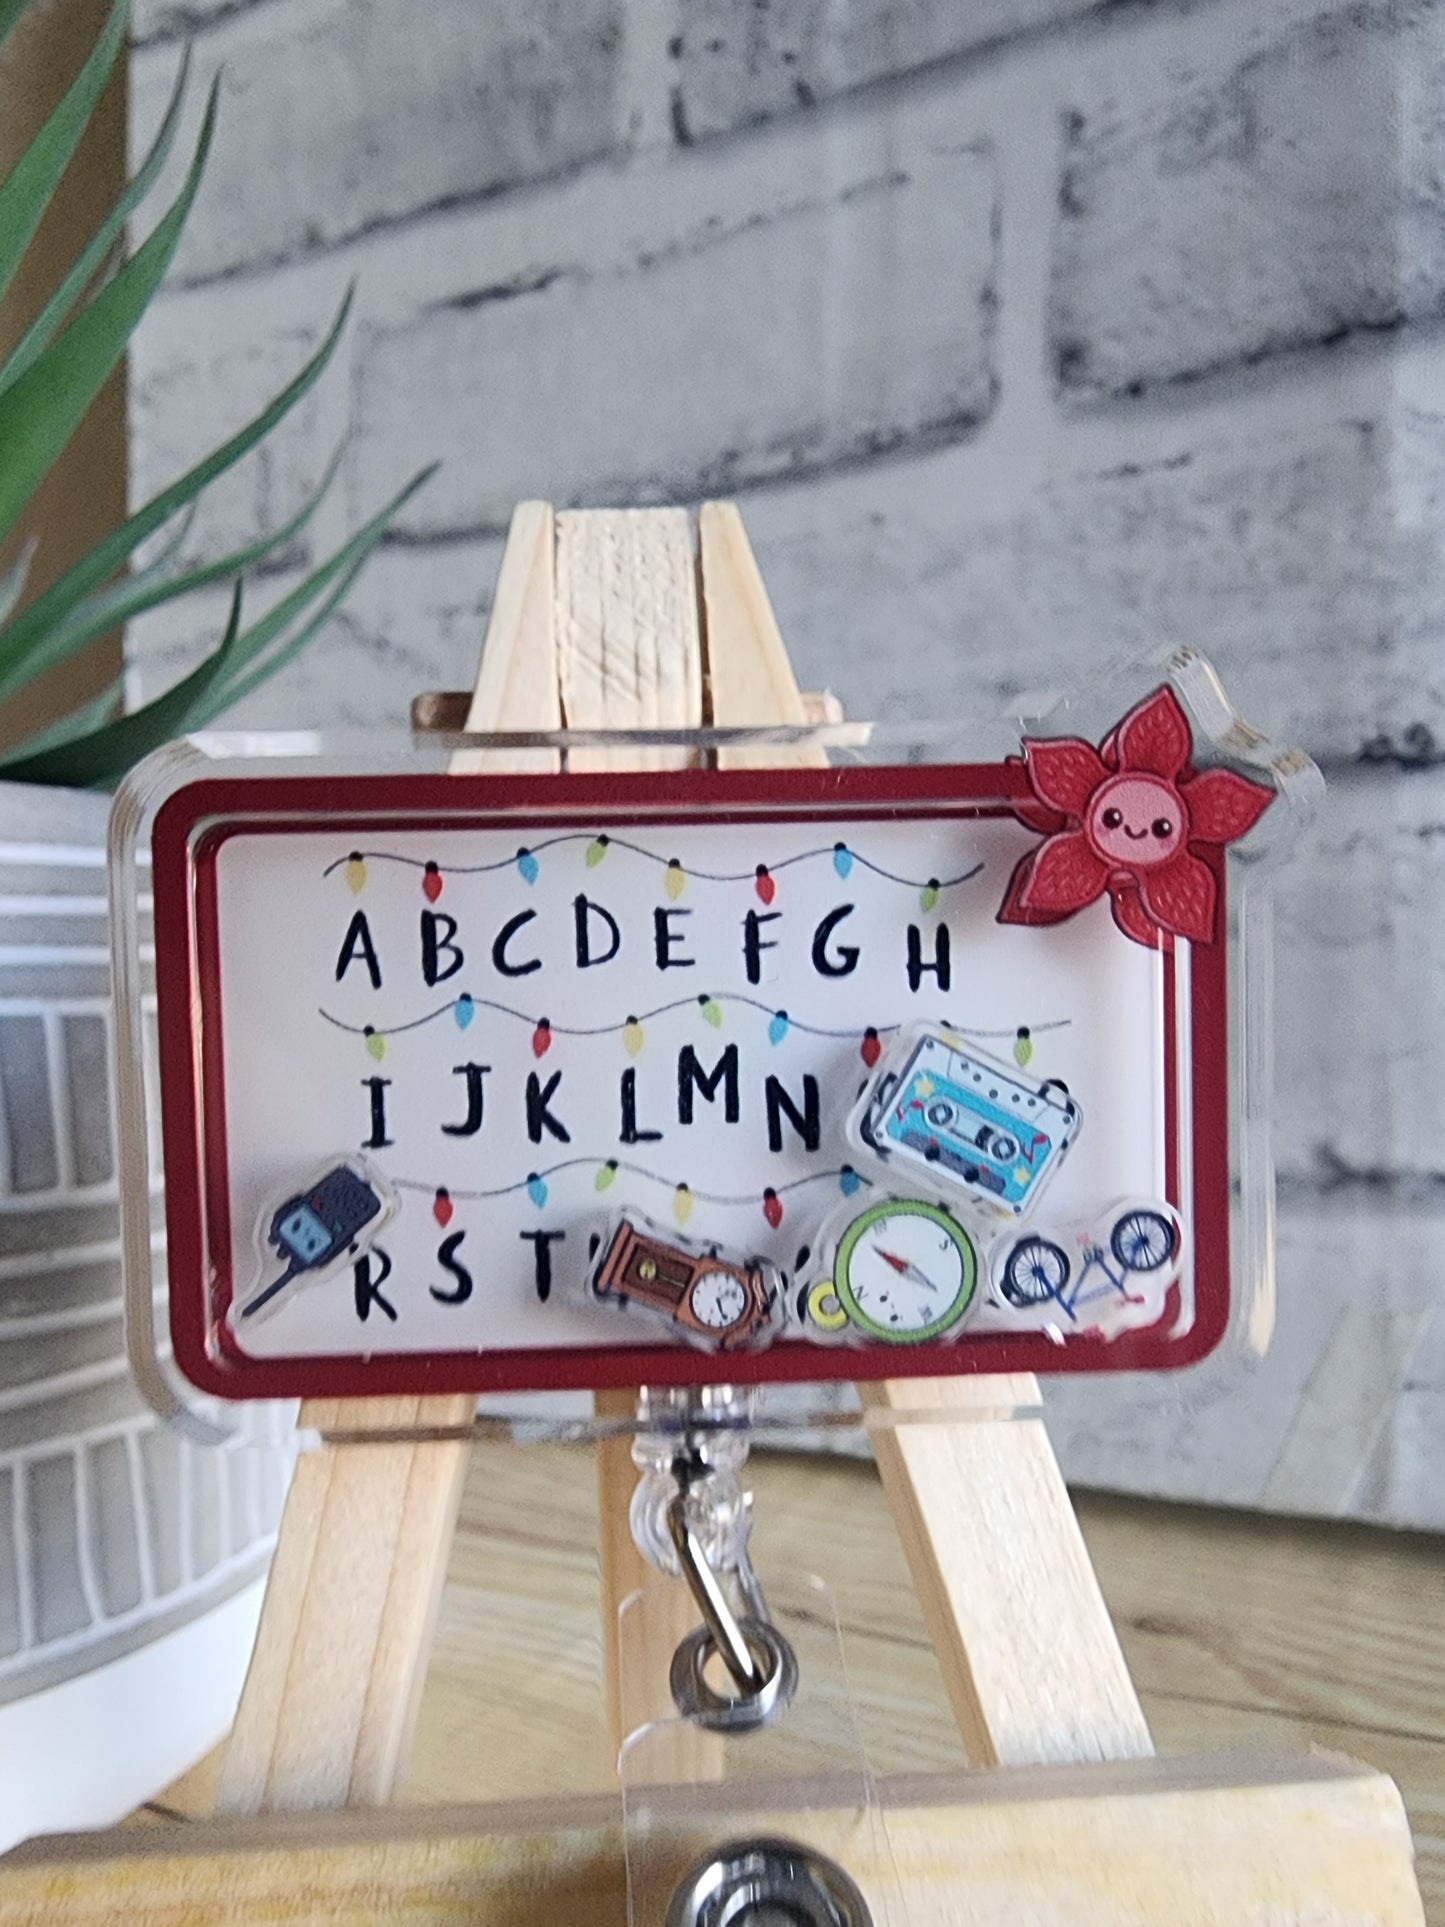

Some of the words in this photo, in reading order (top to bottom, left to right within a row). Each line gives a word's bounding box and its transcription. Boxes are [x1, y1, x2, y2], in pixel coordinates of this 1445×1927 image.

[335, 909, 383, 990] A
[420, 909, 465, 987] B
[491, 909, 542, 977] C
[573, 893, 621, 968] D
[654, 907, 696, 971] E
[743, 909, 782, 985] F
[811, 903, 861, 977] G
[906, 922, 952, 992] H
[360, 1076, 395, 1149] I
[440, 1062, 492, 1136] J
[525, 1068, 571, 1144] K
[619, 1067, 663, 1144] L
[677, 1043, 740, 1125] M
[765, 1074, 821, 1153] N
[348, 1240, 399, 1322] R
[429, 1230, 473, 1305] S
[519, 1229, 566, 1303] T
